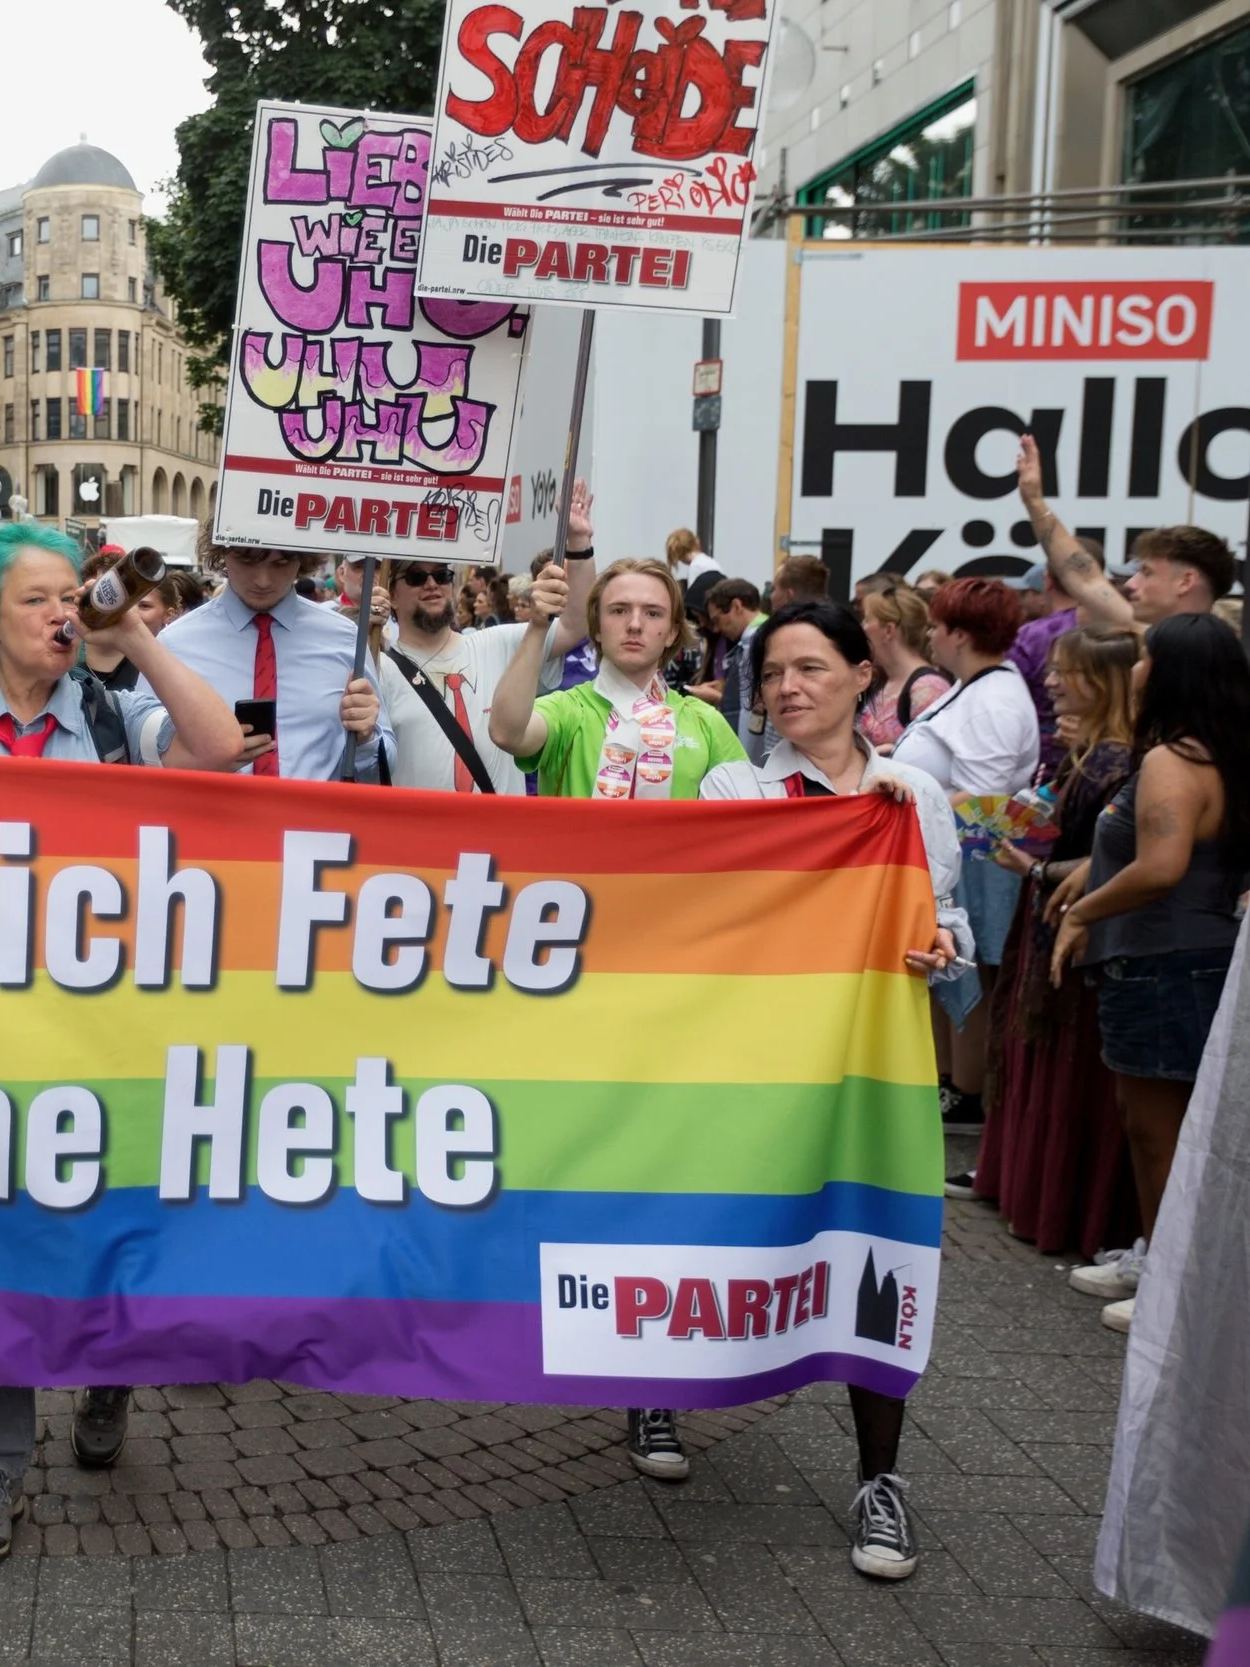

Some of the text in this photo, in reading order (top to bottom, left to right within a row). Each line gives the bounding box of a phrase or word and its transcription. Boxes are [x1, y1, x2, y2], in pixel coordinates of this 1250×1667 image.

[504, 207, 528, 218] Wählt
[530, 208, 542, 219] Die
[545, 210, 589, 221] PARTEI
[598, 214, 611, 224] sie
[613, 215, 624, 224] ist
[627, 216, 646, 225] sehr
[647, 217, 665, 227] gut!
[417, 283, 465, 295] die-partei.nrw
[462, 234, 691, 289] Die PARTEI
[974, 294, 1198, 348] MINISO
[801, 376, 1250, 502] Hallo
[295, 464, 318, 475] Wählt
[319, 466, 331, 476] Die
[333, 468, 372, 479] PARTEI
[381, 472, 392, 482] sie
[393, 473, 404, 483] ist
[405, 474, 422, 484] sehr
[423, 475, 439, 486] gut!
[257, 488, 463, 542] Die PARTEI
[277, 829, 588, 990] Fete
[159, 1044, 498, 1203] Hete
[557, 1260, 830, 1340] Die PARTEI
[897, 1285, 917, 1351] KÖLN
